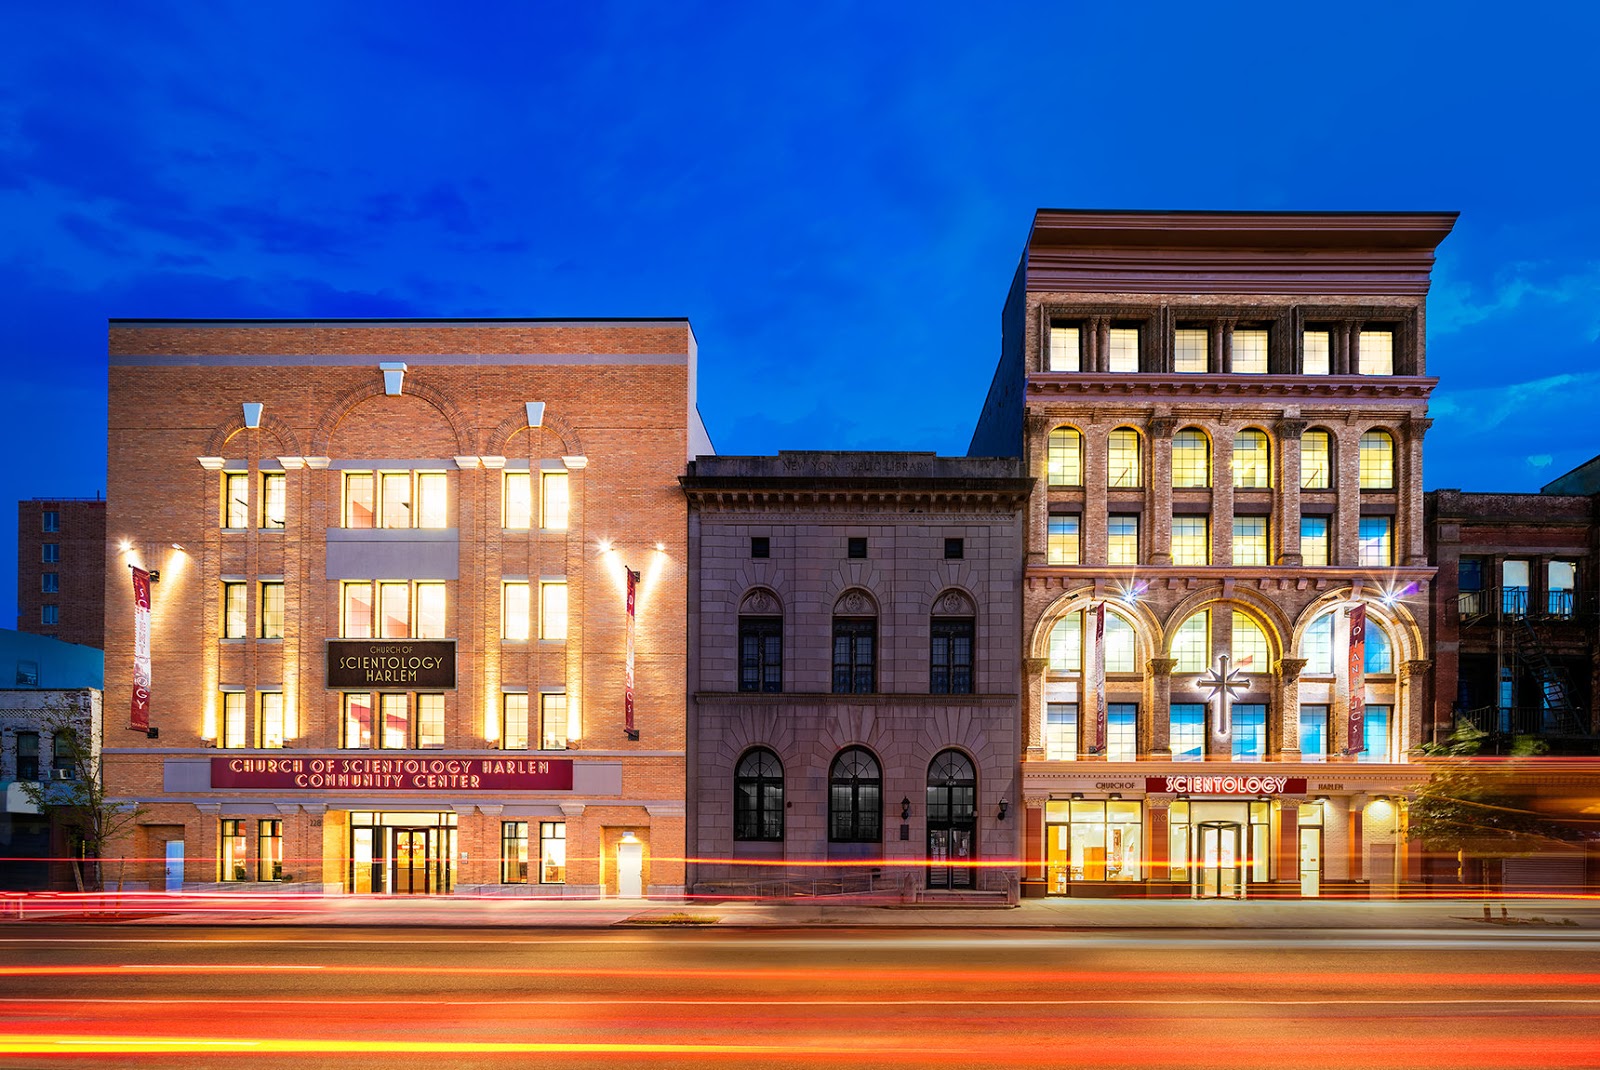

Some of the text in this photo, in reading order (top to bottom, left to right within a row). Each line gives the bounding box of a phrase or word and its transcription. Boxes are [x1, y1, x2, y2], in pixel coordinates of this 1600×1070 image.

[782, 461, 931, 472] NEW YORK PUBLIC LIBRARY
[370, 646, 413, 654] CHURCH OF
[340, 656, 443, 669] SCIENTOLOGY
[366, 669, 417, 682] HARLEM
[229, 759, 549, 774] CHURCH OF SCIENTOLOGY HARLEM
[295, 773, 480, 788] COMMUNITY CENTER
[1095, 782, 1124, 790] CHURCH
[1166, 776, 1287, 793] SCIENTOLOGY
[310, 819, 322, 827] 228
